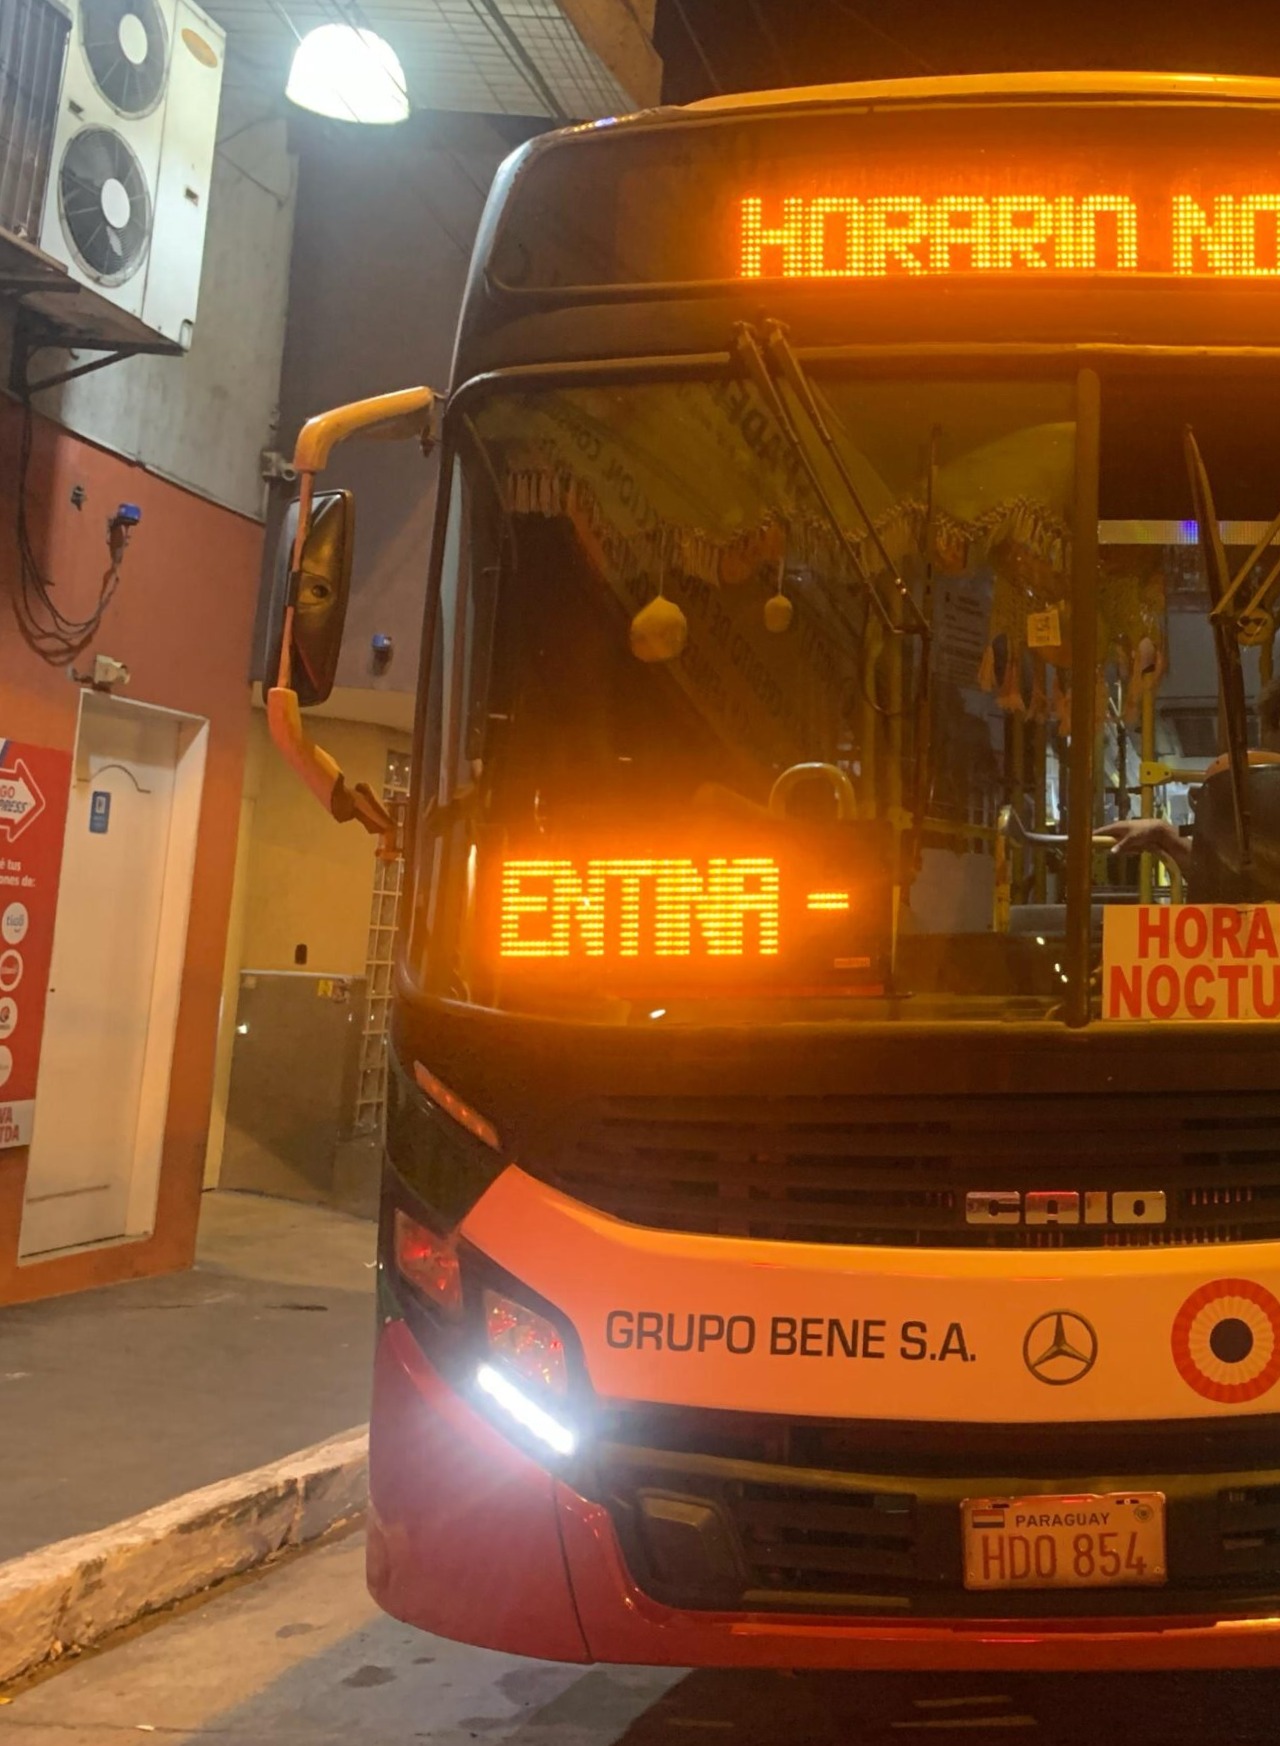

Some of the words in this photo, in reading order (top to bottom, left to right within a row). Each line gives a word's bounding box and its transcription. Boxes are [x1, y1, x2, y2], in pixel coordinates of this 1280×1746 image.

[741, 195, 1138, 277] HORARIO
[500, 858, 779, 957] ENTINA
[966, 1191, 1166, 1224] CAIO
[606, 1310, 755, 1354] GRUPO
[769, 1316, 886, 1358] BENE
[900, 1321, 977, 1362] S.A.
[1015, 1512, 1110, 1528] PARAGUAY
[982, 1534, 1057, 1580] HDO
[1073, 1531, 1146, 1577] 854
